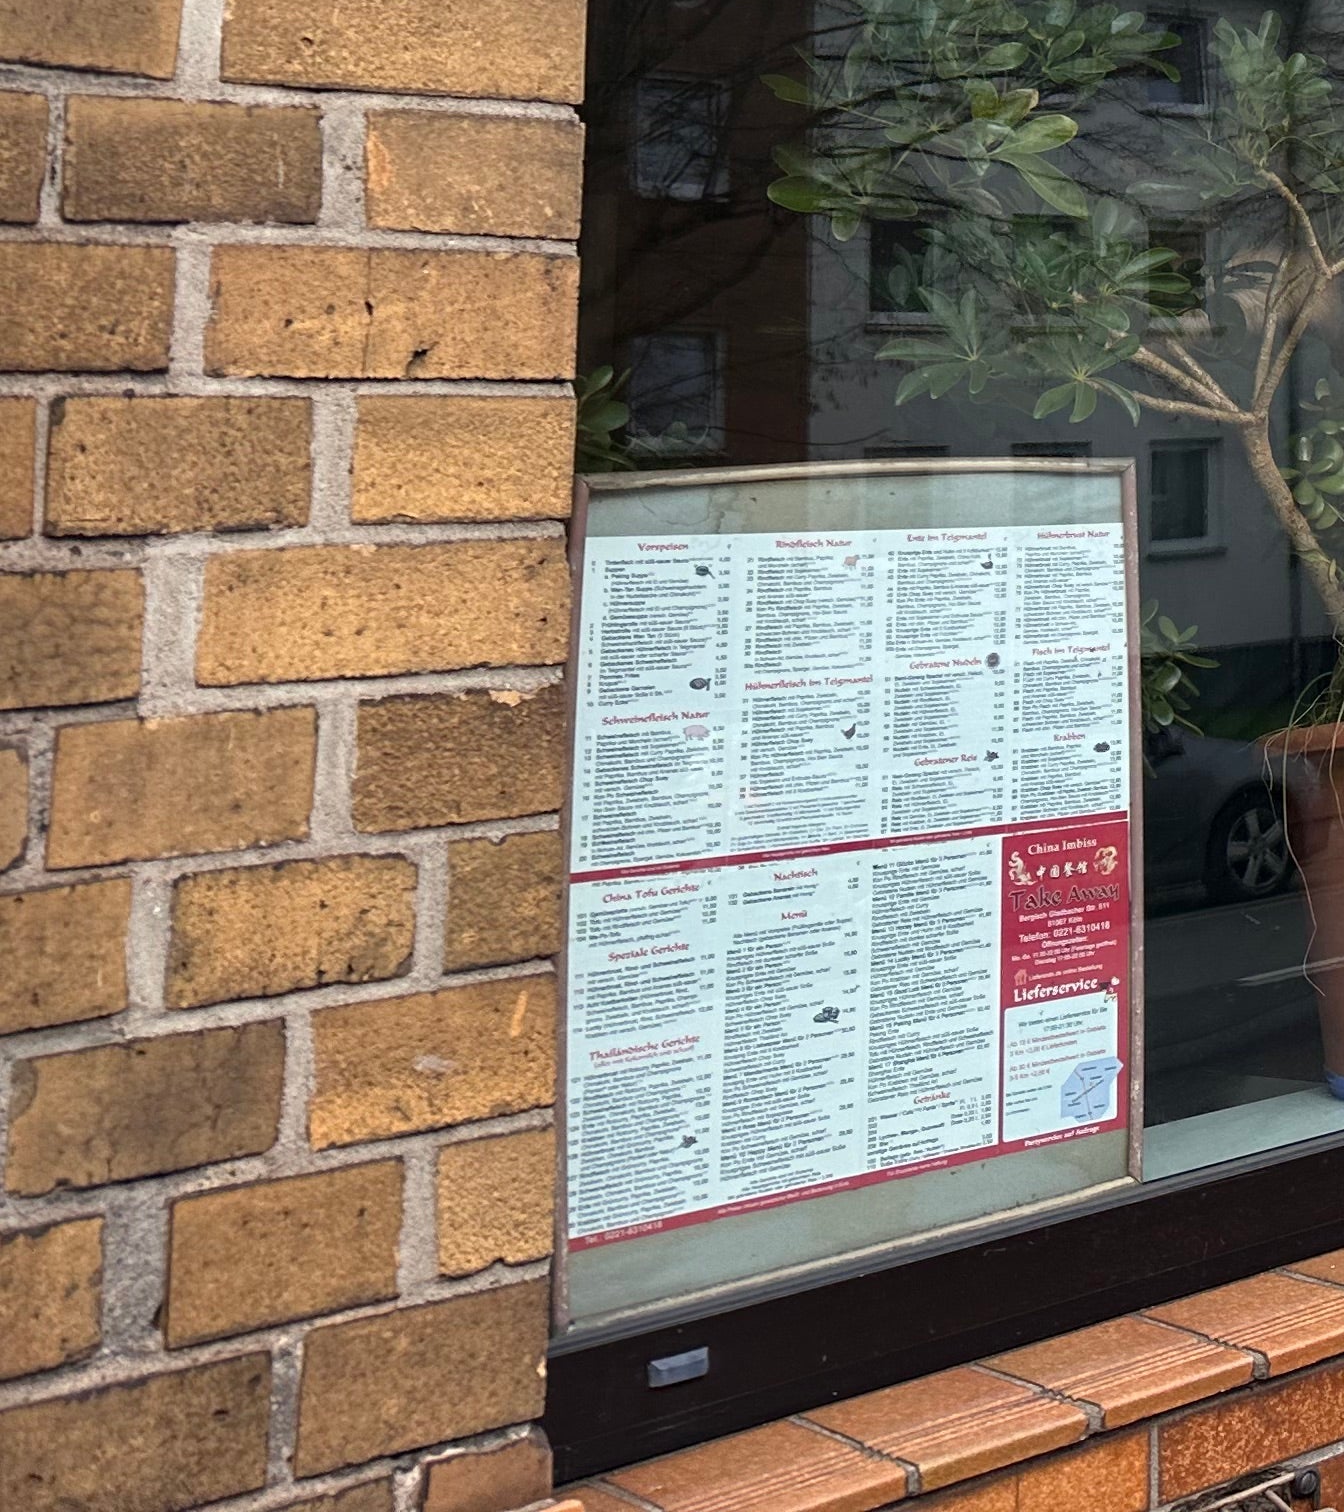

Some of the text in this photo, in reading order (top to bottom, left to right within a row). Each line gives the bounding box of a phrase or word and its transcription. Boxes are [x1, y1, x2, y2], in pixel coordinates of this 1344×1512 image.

[637, 543, 689, 552] Vorspeisen
[602, 712, 678, 726] Schweinefleisch
[1028, 837, 1097, 855] China Imbiss
[603, 893, 633, 904] China
[635, 889, 658, 899] Tofu
[1008, 883, 1121, 913] Take Away
[781, 910, 808, 921] Menü
[608, 942, 690, 963] Speziale Gerichte
[1013, 978, 1099, 1004] Lieferservice
